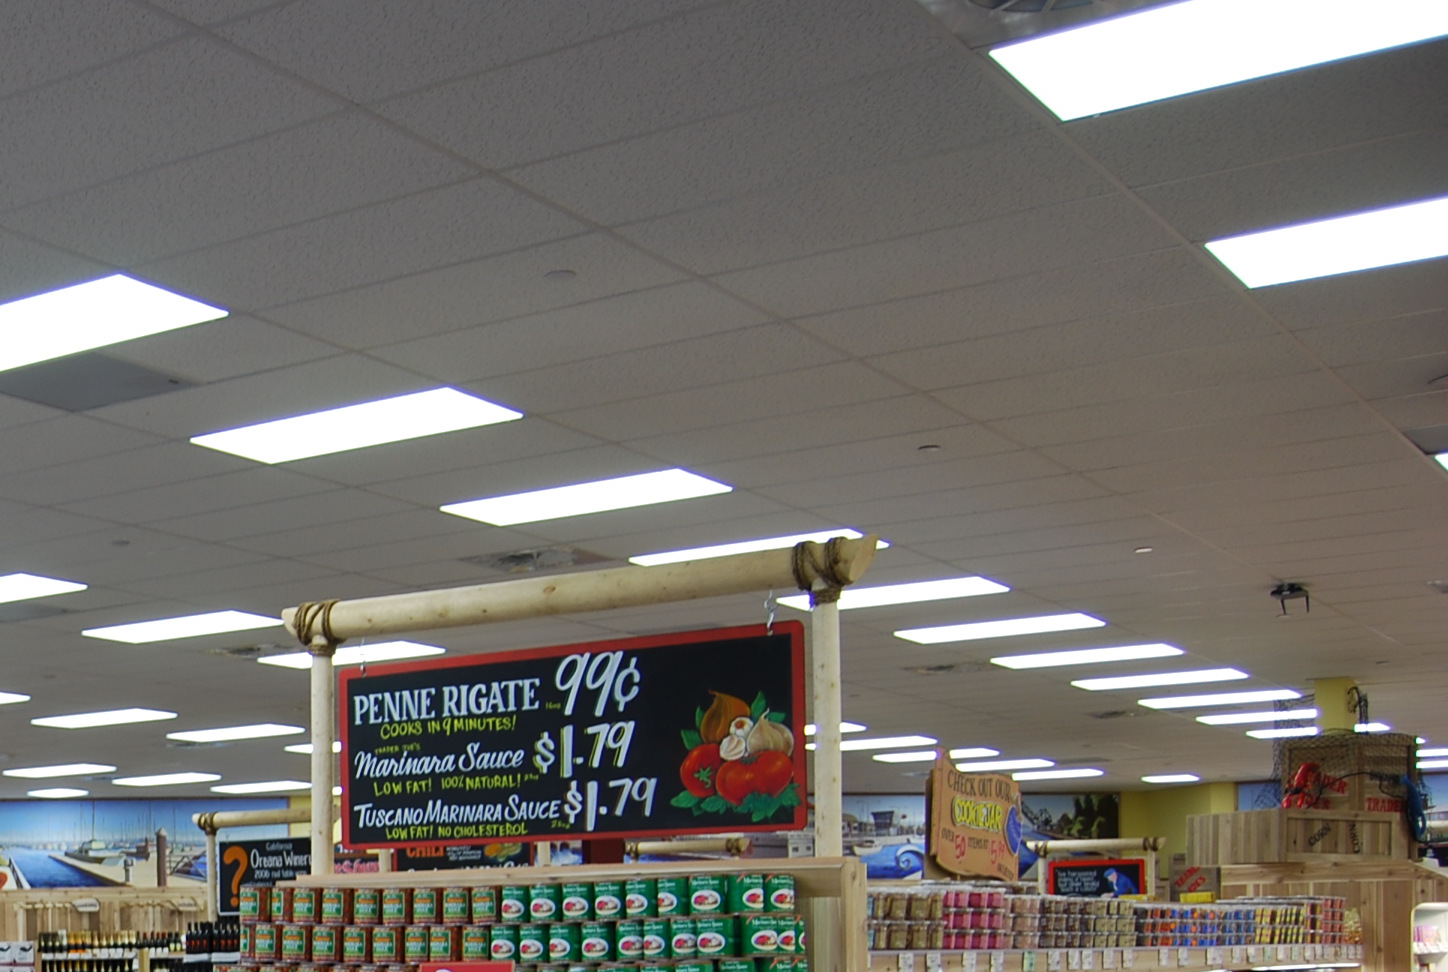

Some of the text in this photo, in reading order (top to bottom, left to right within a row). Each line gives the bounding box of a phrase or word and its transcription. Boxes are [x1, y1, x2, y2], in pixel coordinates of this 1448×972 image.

[353, 687, 437, 726] PENNE
[441, 677, 541, 719] RIGATE
[555, 650, 641, 718] 99¢
[380, 721, 423, 740] COOKS
[427, 720, 440, 734] IN
[454, 714, 517, 733] MINUTES!
[354, 719, 636, 780] Marinara Sauce $1.79
[373, 782, 403, 797] LOW
[406, 778, 432, 795] FAT!
[441, 775, 465, 790] 100%
[466, 772, 522, 791] NATURAL!
[947, 769, 1012, 804] CHECK OUT OUR
[504, 793, 562, 823] SAUCE
[563, 777, 658, 833] $1.79
[386, 826, 409, 841] LOW
[409, 822, 433, 840] FAT!
[438, 825, 452, 838] NO
[453, 820, 529, 839] CHOLESTEROL
[1307, 822, 1332, 847] CORN
[250, 848, 284, 869] Oreana
[954, 833, 967, 860] 50
